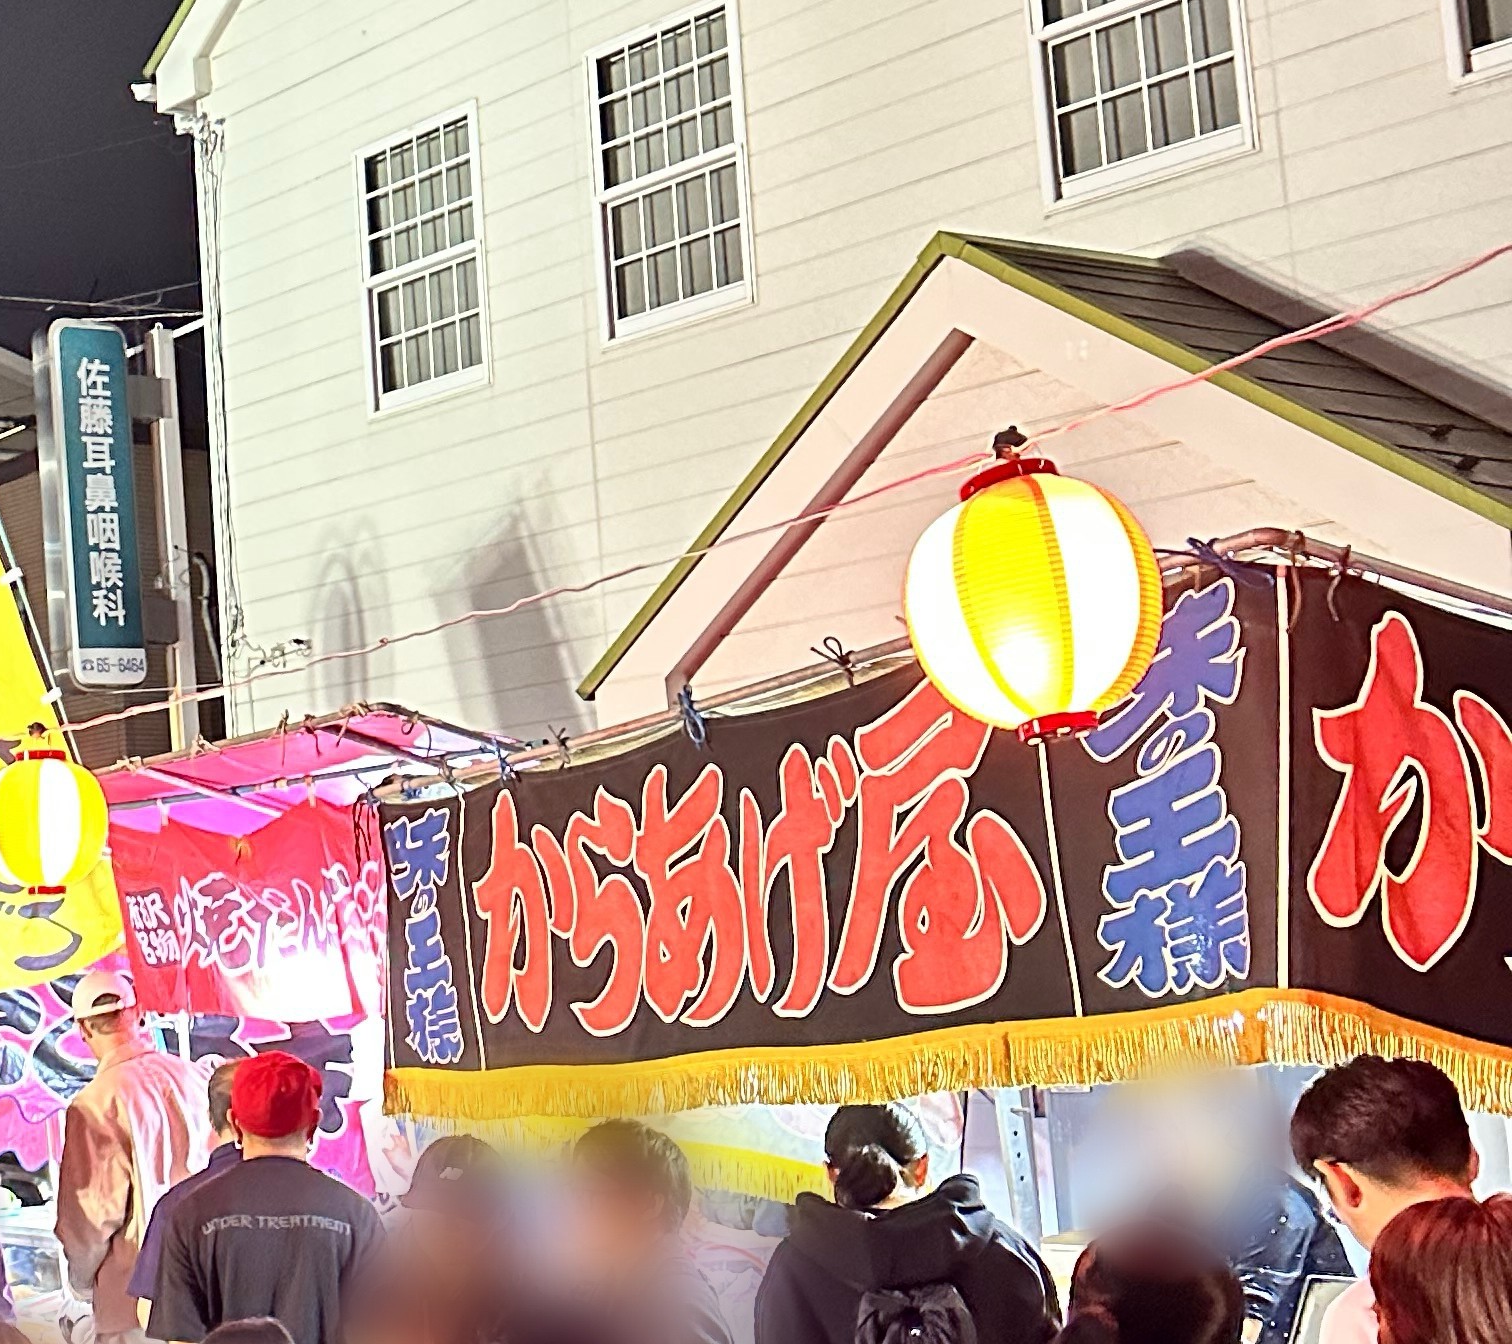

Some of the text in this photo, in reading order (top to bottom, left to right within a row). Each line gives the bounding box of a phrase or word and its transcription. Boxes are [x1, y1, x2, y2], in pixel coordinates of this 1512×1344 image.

[76, 356, 126, 627] 佐藤耳鼻咽喉科
[383, 806, 466, 1064] 味の王様
[472, 676, 1048, 1037] からあげ屋
